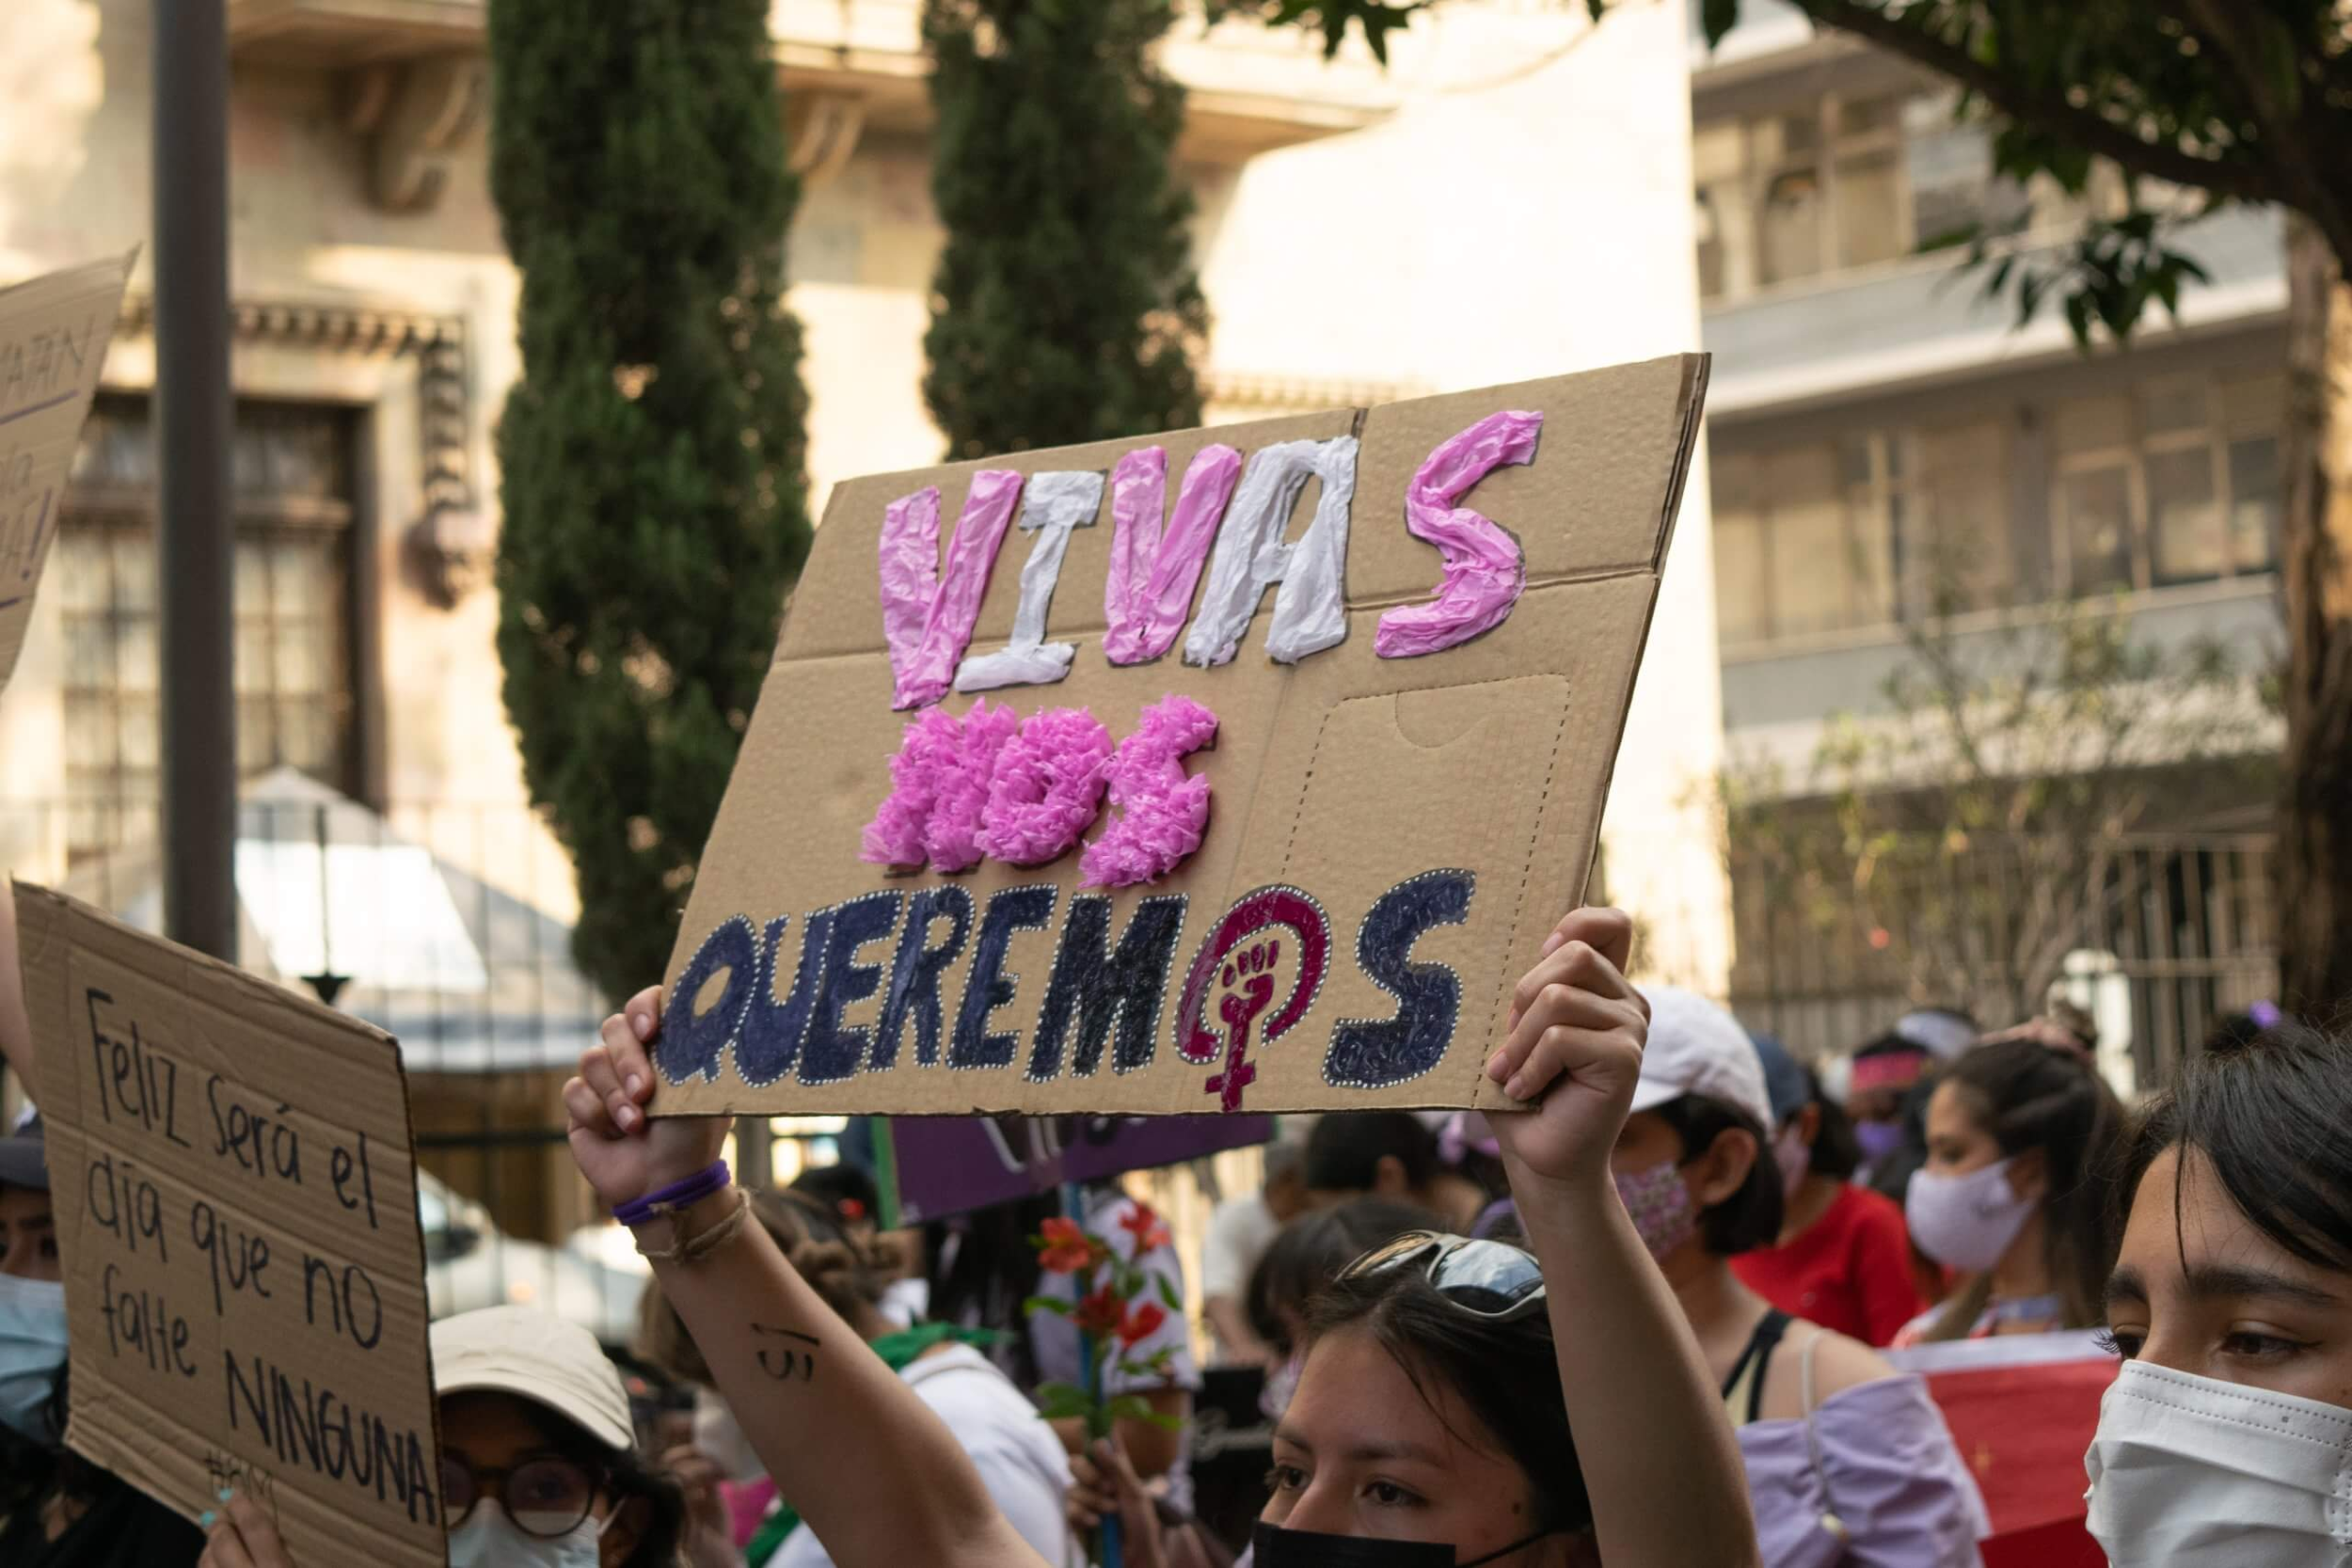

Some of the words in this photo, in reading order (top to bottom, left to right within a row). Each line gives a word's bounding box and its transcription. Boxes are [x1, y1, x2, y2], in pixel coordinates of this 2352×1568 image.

[878, 409, 1546, 712] VIVAS
[858, 691, 1220, 889] NOS
[87, 988, 191, 1148] Feliz
[332, 1130, 378, 1229] el
[102, 1263, 197, 1377] falte
[224, 1348, 437, 1525] NINGUNA
[191, 1200, 271, 1316] que
[303, 1251, 382, 1350] no
